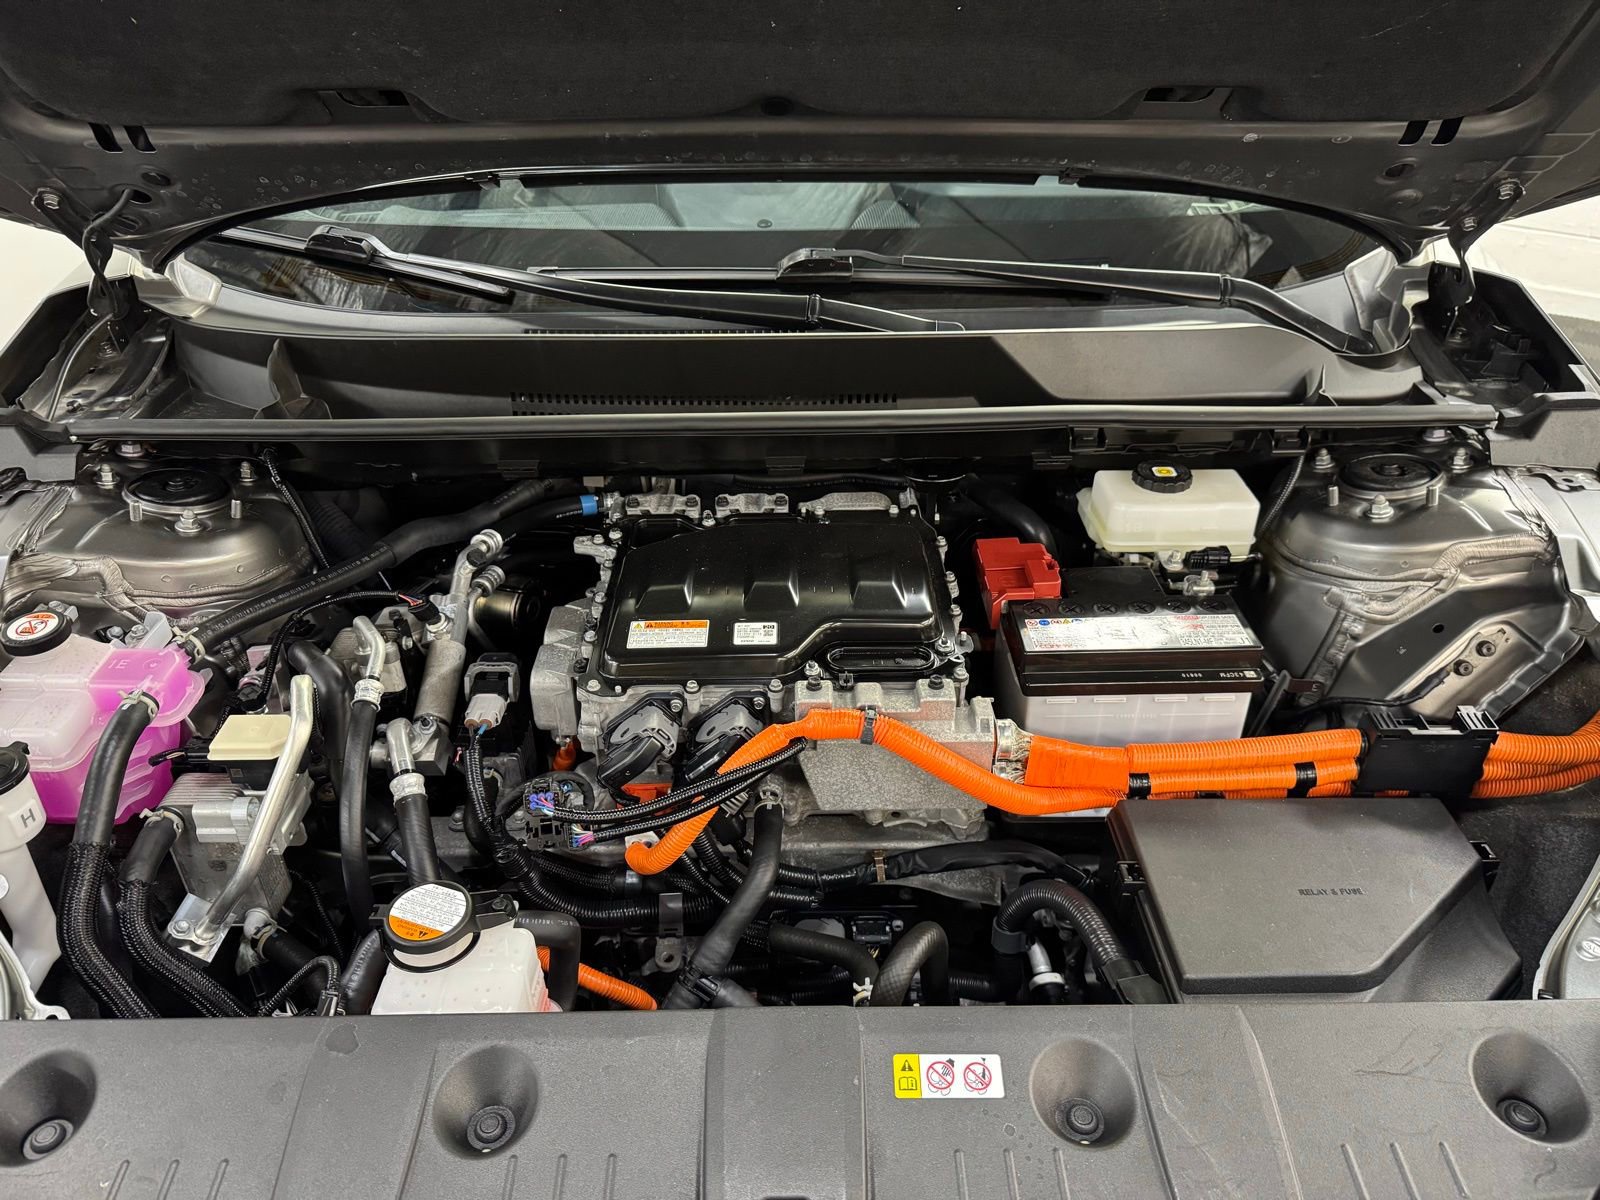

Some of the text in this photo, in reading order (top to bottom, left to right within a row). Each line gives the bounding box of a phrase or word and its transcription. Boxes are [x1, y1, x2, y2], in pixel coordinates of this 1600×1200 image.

[20, 808, 36, 828] H
[1297, 887, 1363, 896] RELAY & FUSE
